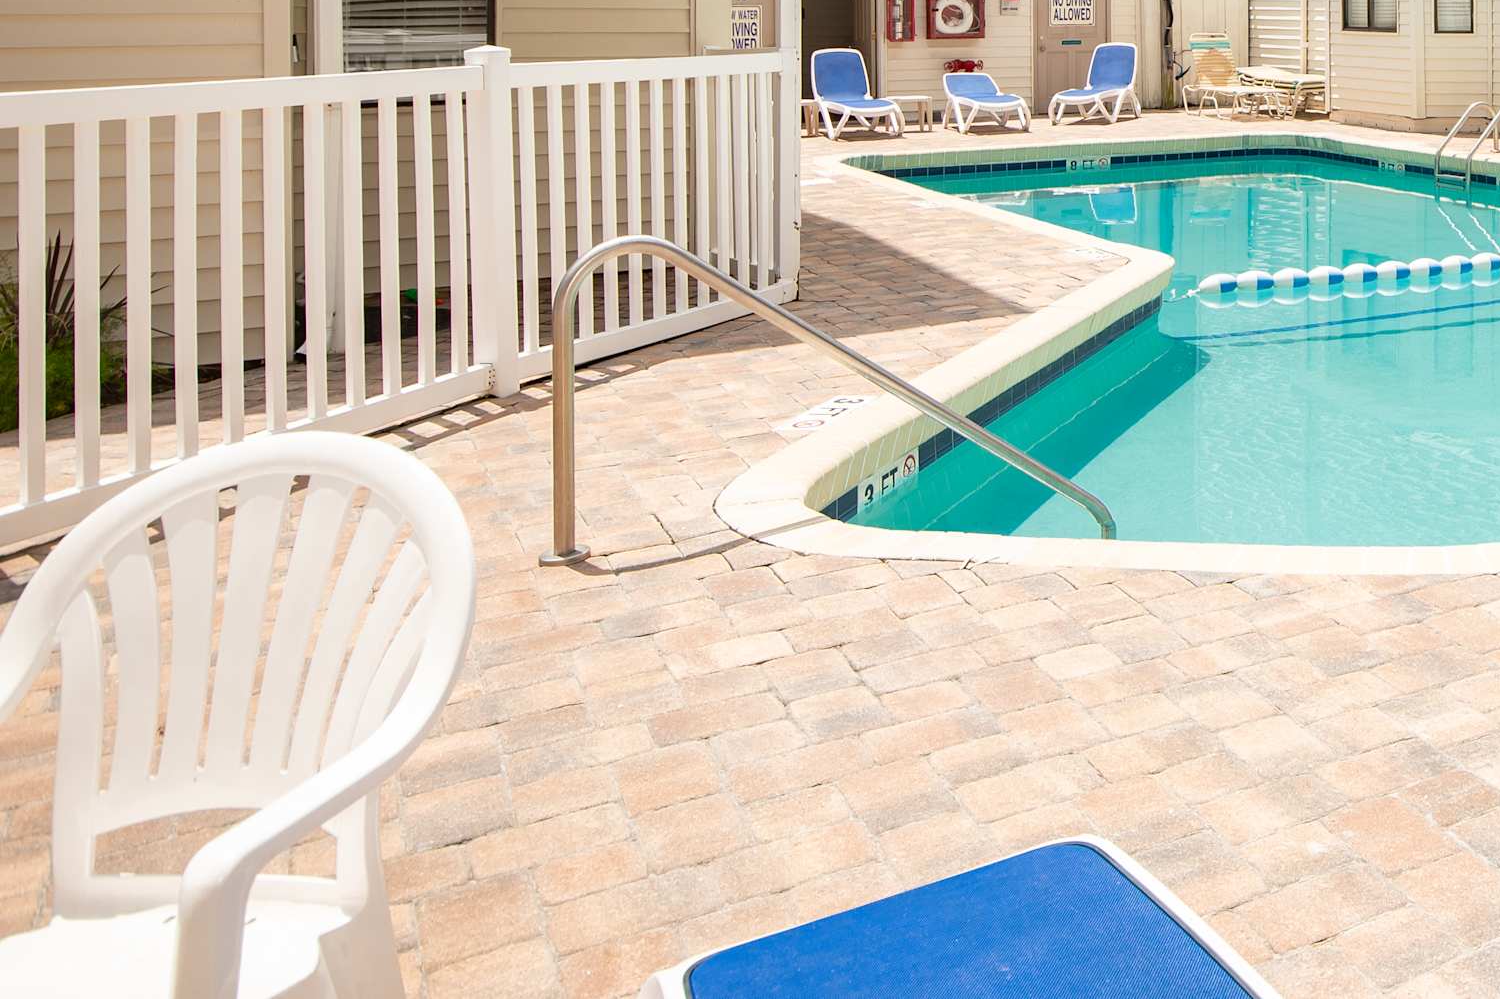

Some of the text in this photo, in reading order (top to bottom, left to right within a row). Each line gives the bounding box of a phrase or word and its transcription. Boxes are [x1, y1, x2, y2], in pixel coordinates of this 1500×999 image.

[738, 10, 758, 19] WATER
[1054, 8, 1091, 21] ALLOWED
[732, 22, 757, 36] IVING
[864, 466, 898, 506] 3 FT
